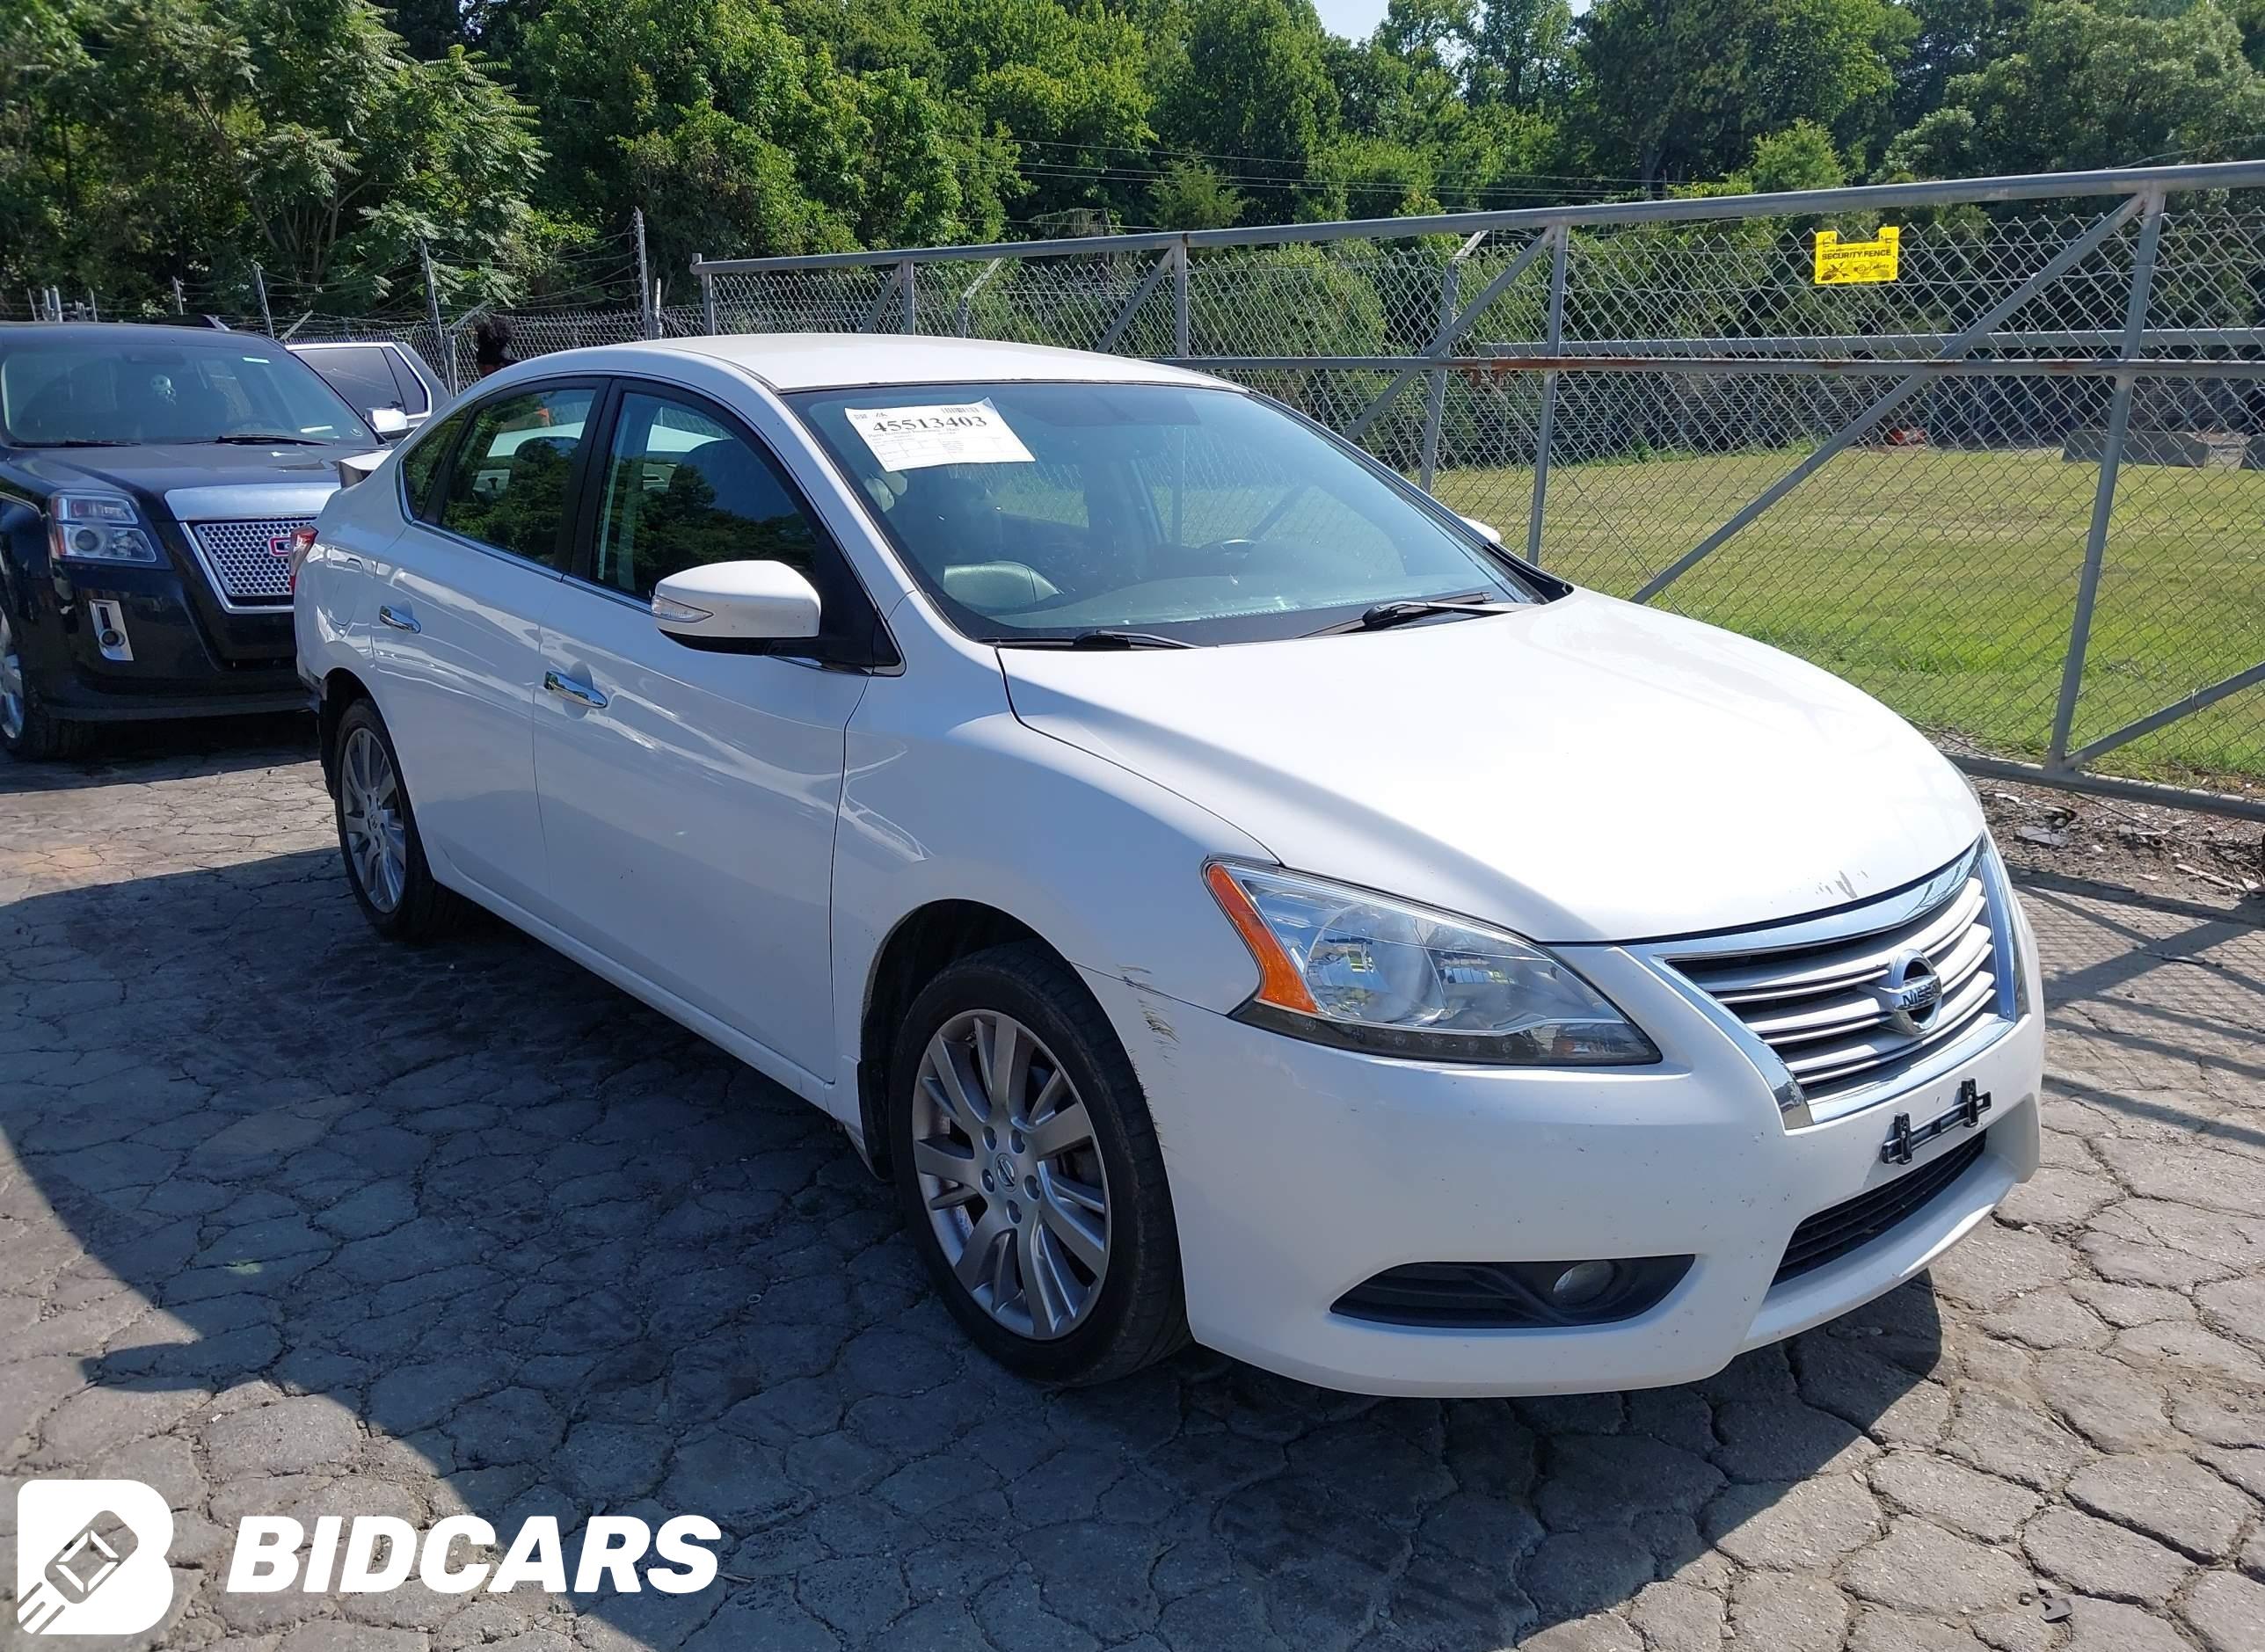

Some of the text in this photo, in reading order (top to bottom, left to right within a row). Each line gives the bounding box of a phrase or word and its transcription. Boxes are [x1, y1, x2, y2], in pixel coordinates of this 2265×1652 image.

[1822, 249, 1891, 260] SECURITY FENCE
[872, 415, 987, 433] 45513403
[1902, 980, 1941, 1007] NISS
